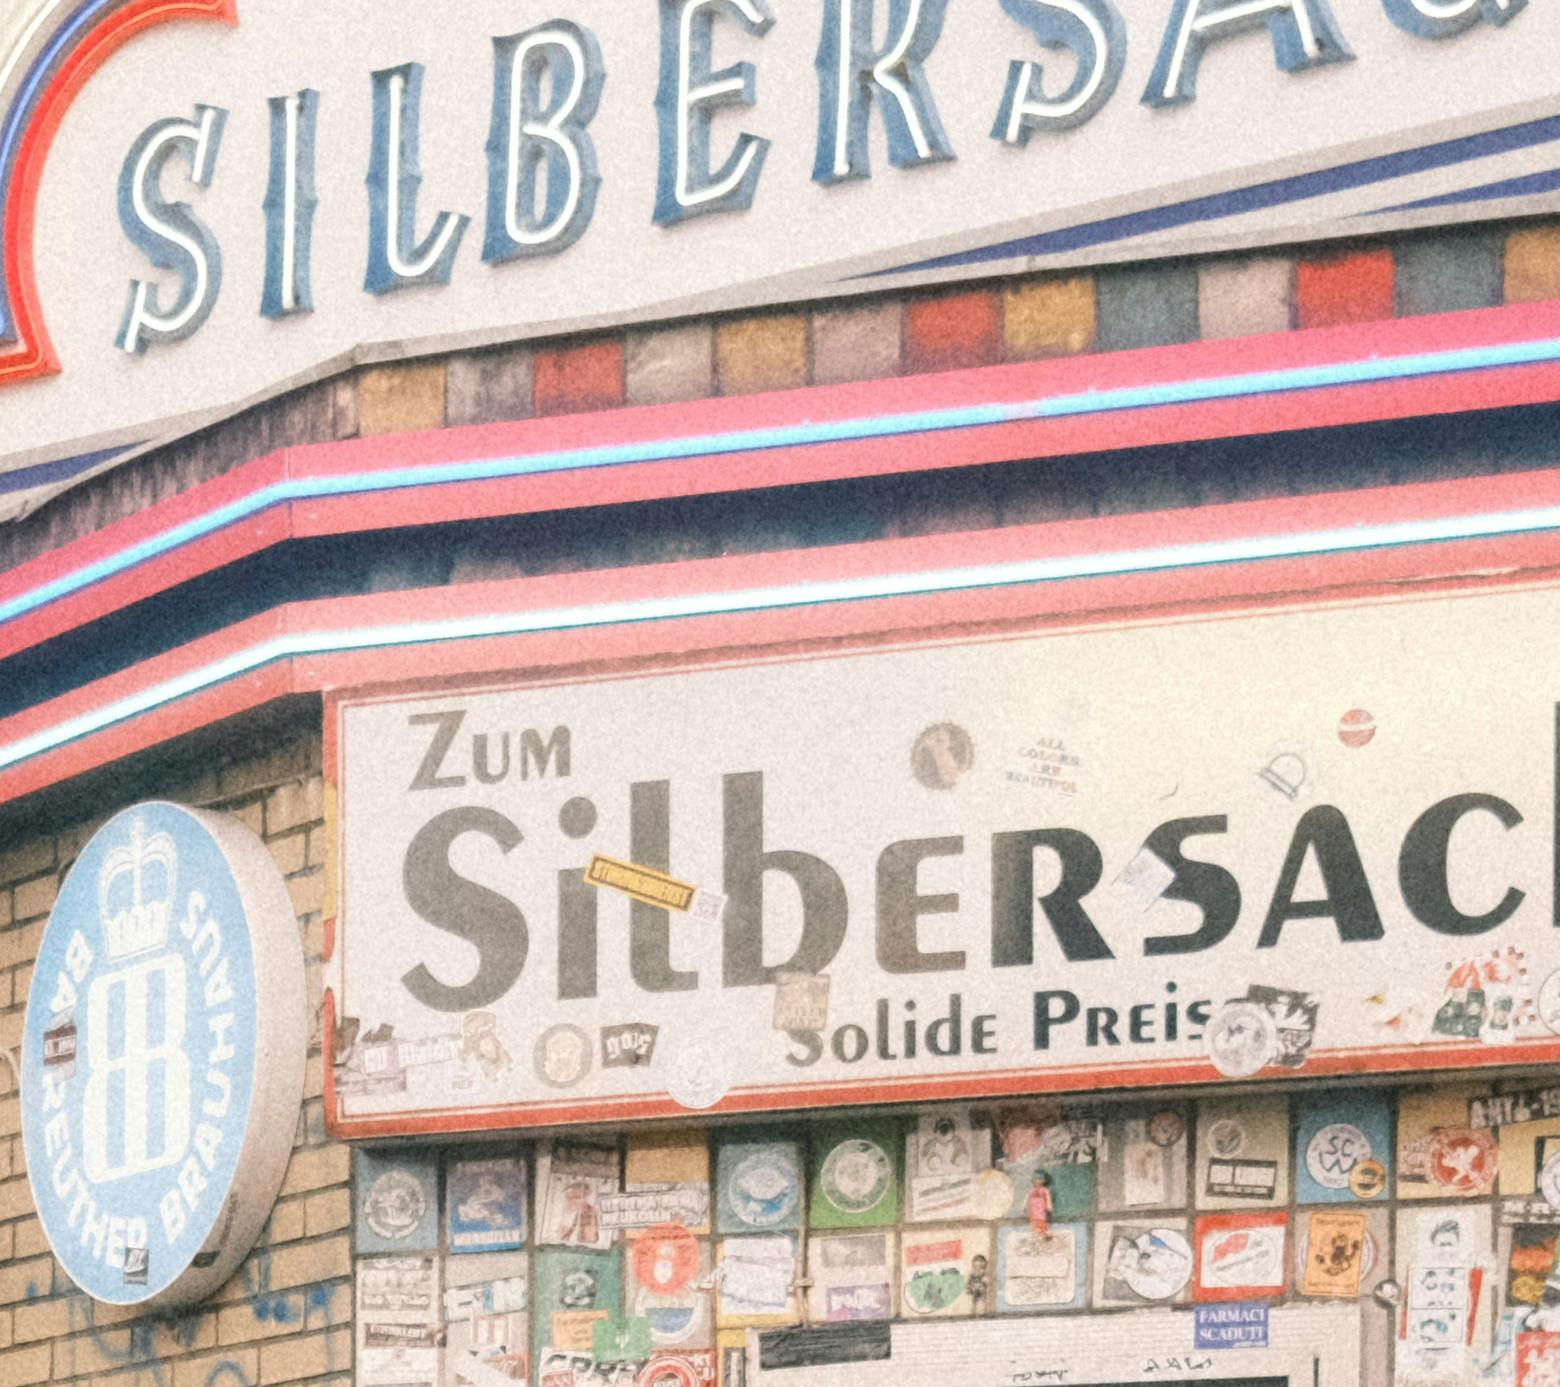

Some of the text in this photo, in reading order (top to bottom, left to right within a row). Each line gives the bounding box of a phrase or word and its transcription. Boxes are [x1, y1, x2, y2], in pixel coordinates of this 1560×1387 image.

[785, 998, 999, 1066] Solide
[160, 891, 238, 1246] BRAUHAUS
[1197, 1326, 1266, 1342] SCADUTI
[1198, 1309, 1265, 1323] FARMACI
